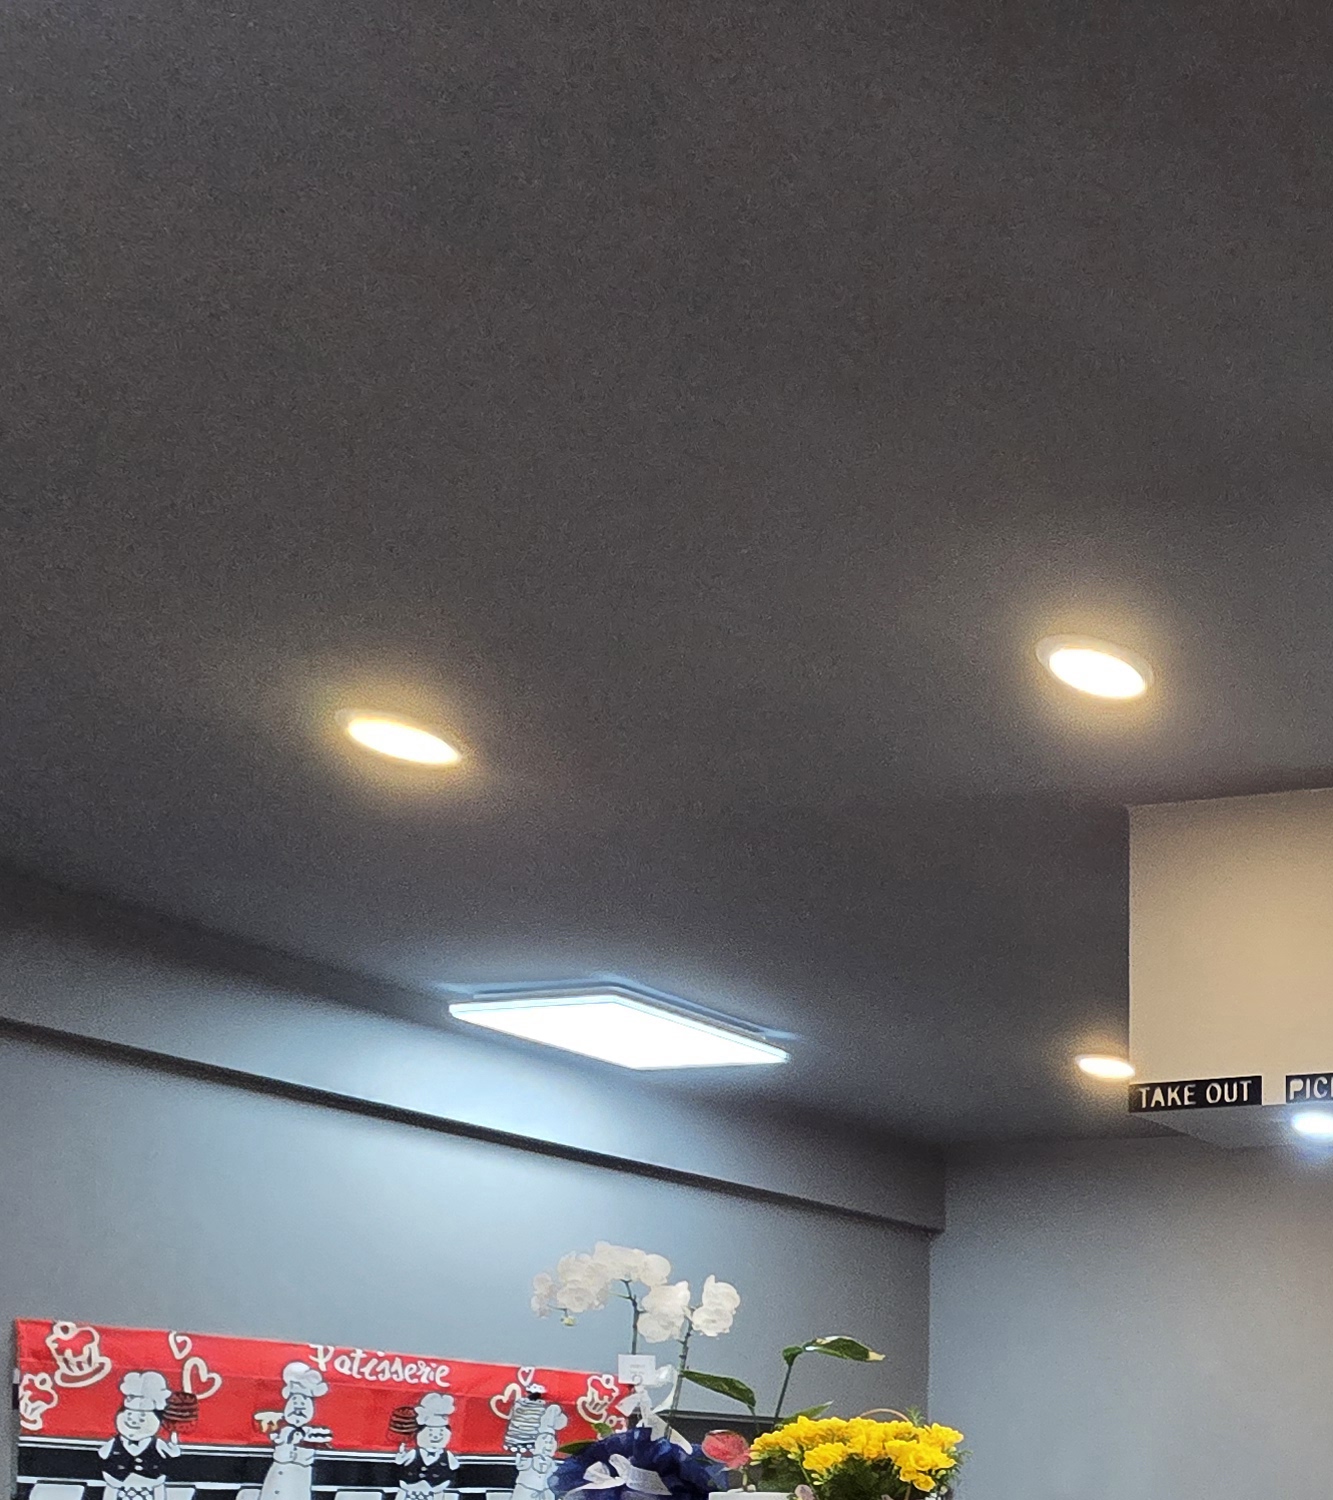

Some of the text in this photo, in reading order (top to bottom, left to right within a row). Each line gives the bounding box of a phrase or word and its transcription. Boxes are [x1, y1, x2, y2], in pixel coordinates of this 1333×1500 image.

[1138, 1080, 1253, 1109] TAKE OUT
[308, 1342, 451, 1388] Patisserie
